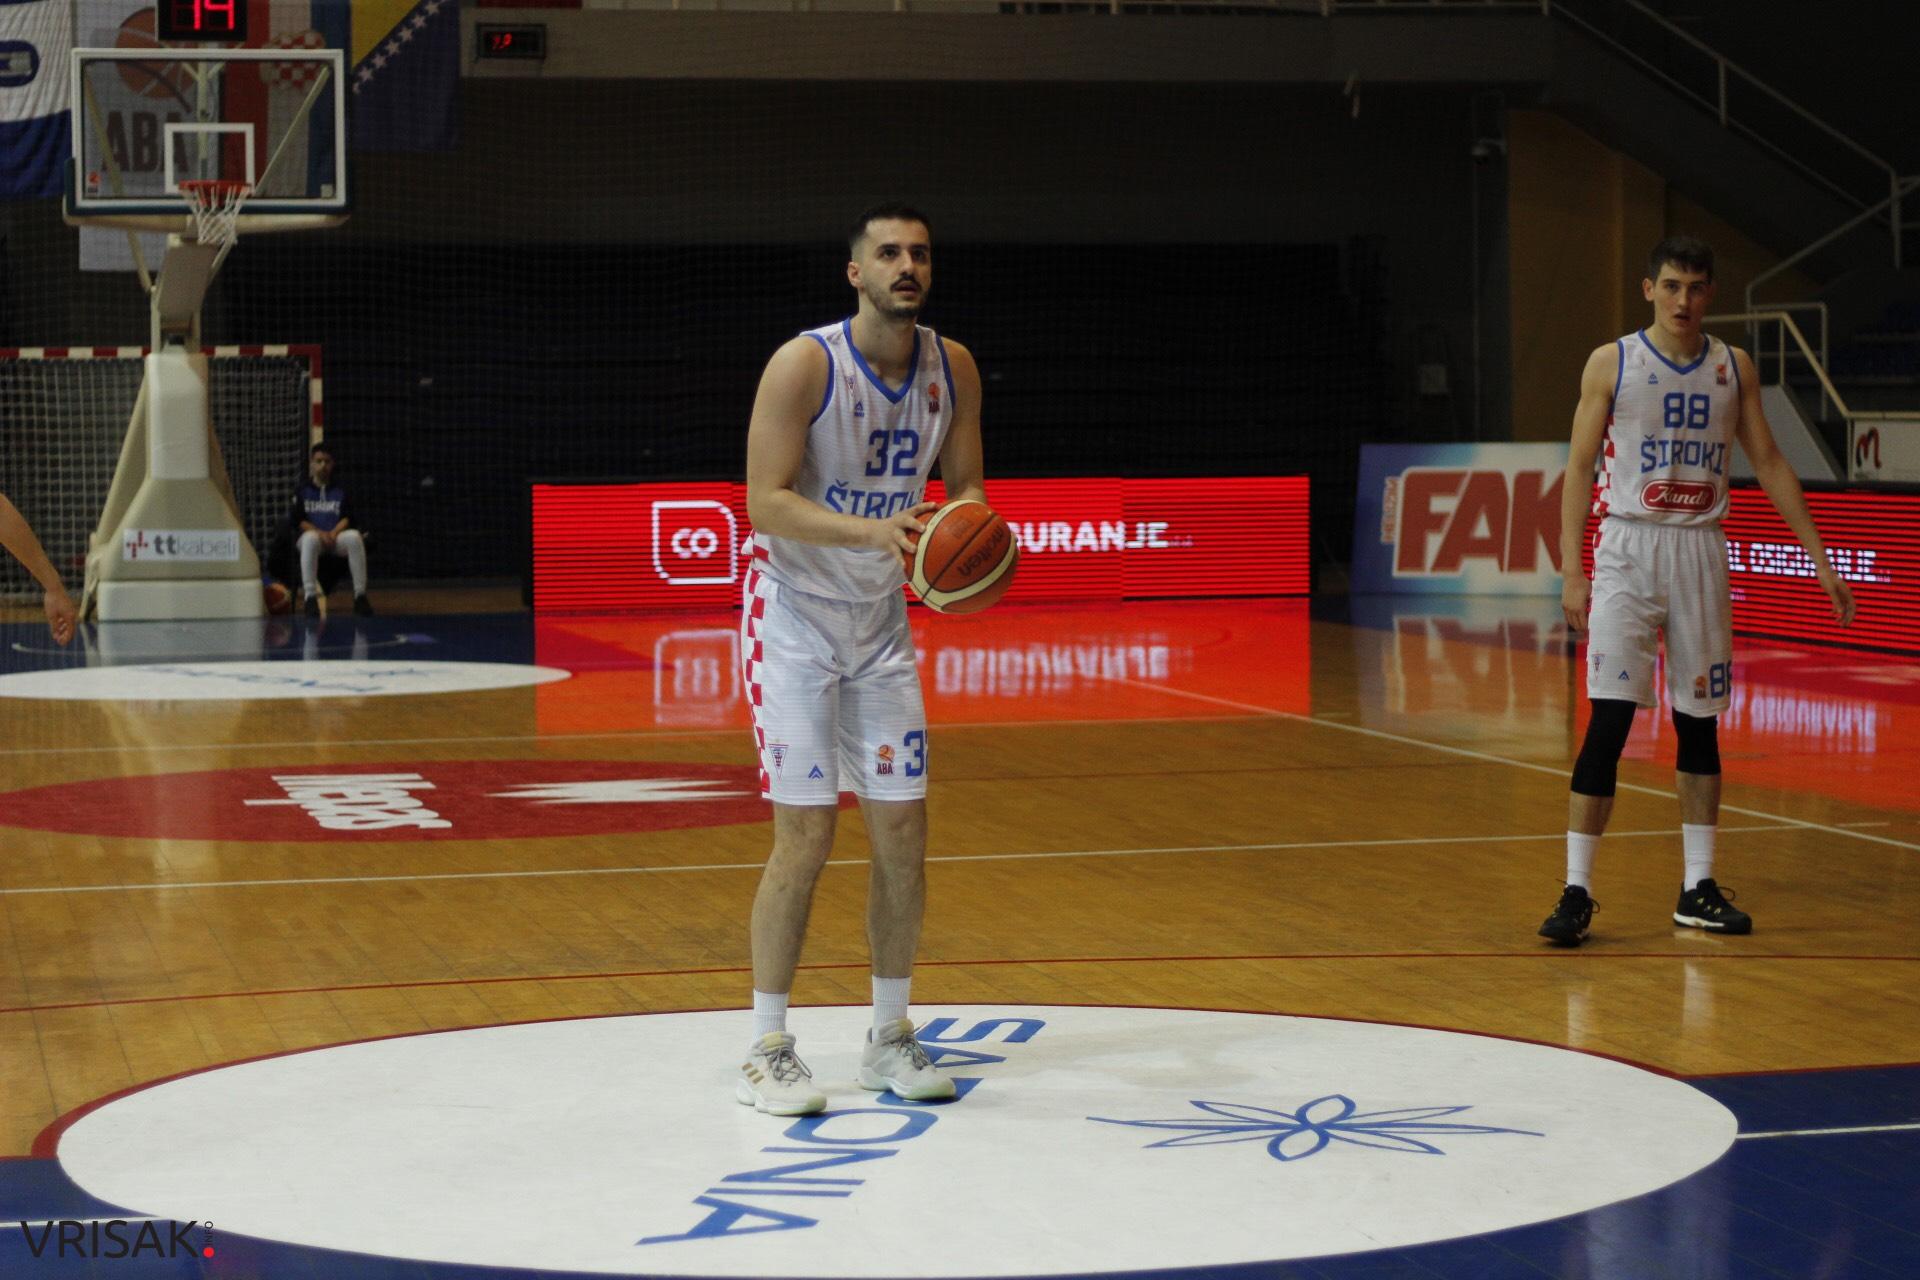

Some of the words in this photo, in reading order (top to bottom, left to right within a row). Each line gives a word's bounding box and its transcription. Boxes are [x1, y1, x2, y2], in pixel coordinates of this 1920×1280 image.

[1663, 392, 1711, 430] 88
[864, 429, 920, 477] 32
[1641, 434, 1726, 476] ŠIROKI
[877, 763, 894, 775] ABA
[903, 729, 928, 777] 3
